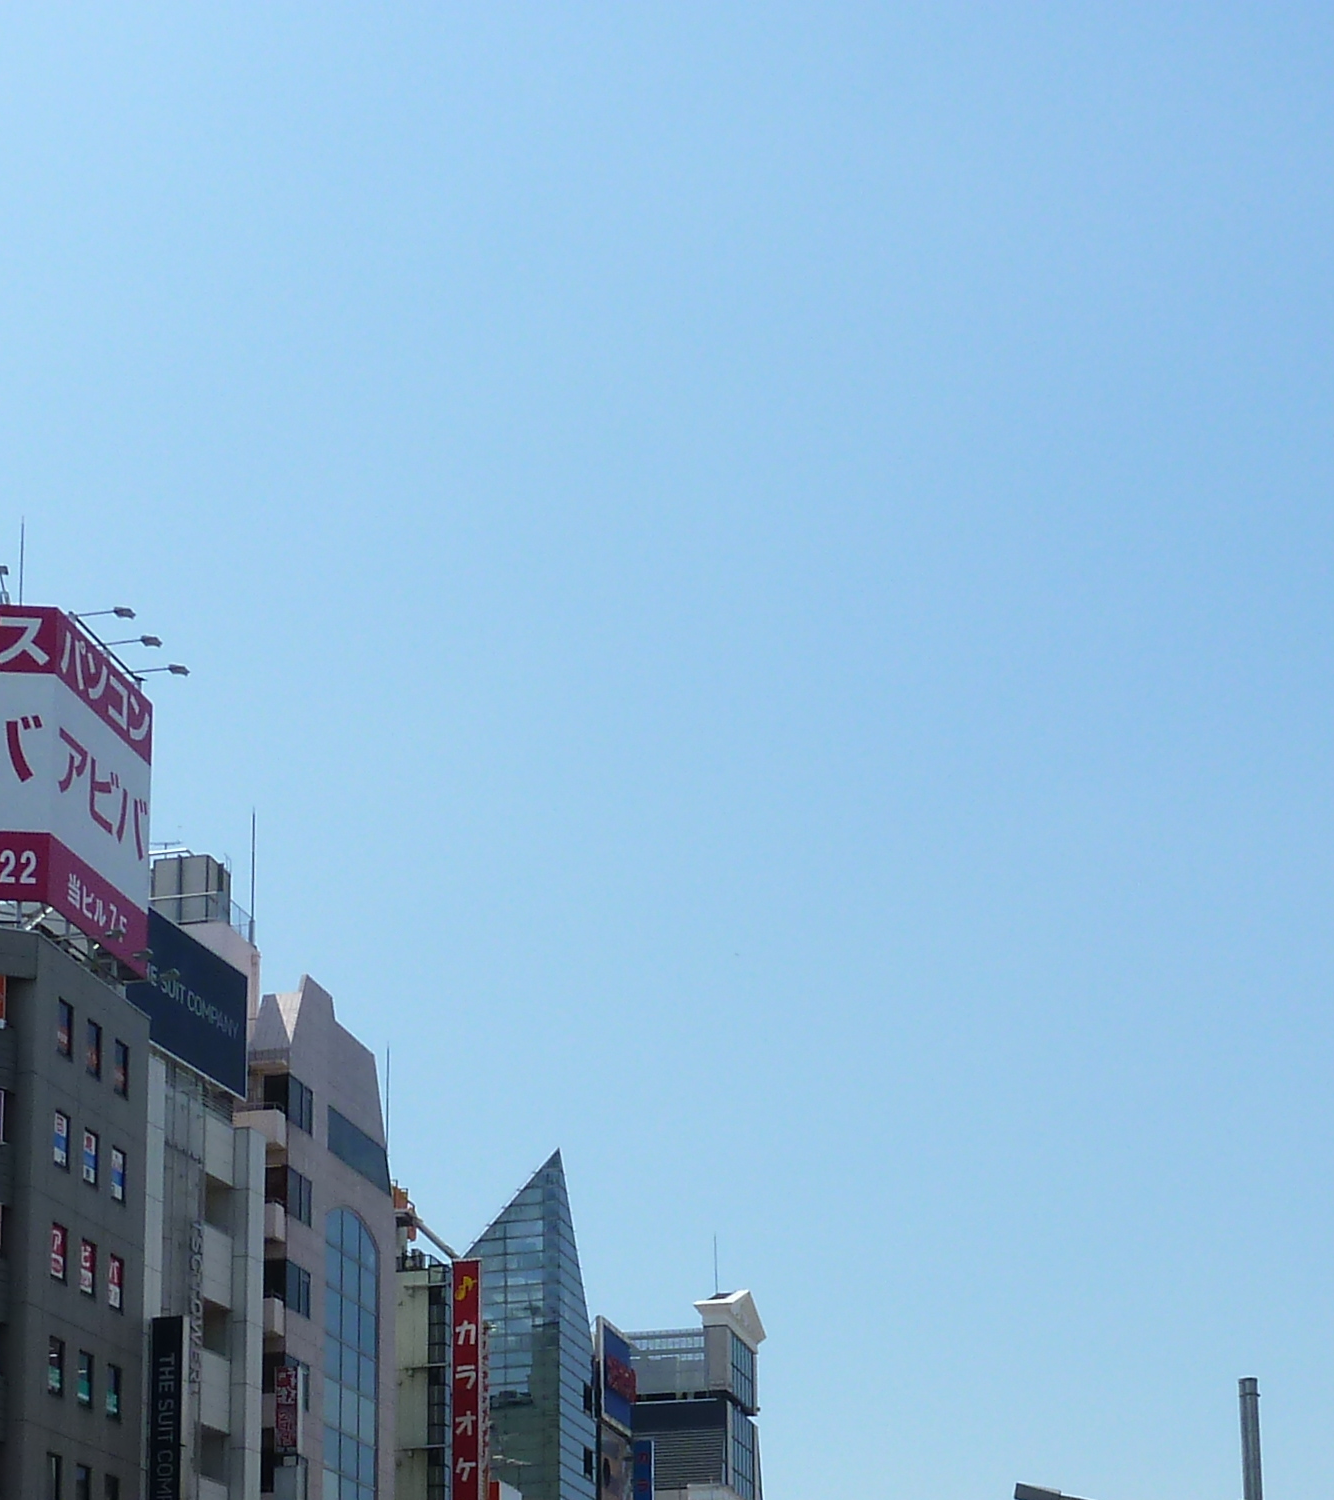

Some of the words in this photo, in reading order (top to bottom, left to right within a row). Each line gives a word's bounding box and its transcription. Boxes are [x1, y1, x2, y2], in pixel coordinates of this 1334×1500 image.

[60, 630, 151, 742] パソコン
[57, 726, 150, 862] アビバ
[186, 989, 240, 1039] COMPANY
[157, 1353, 177, 1393] THE
[156, 1400, 176, 1434] SUIT
